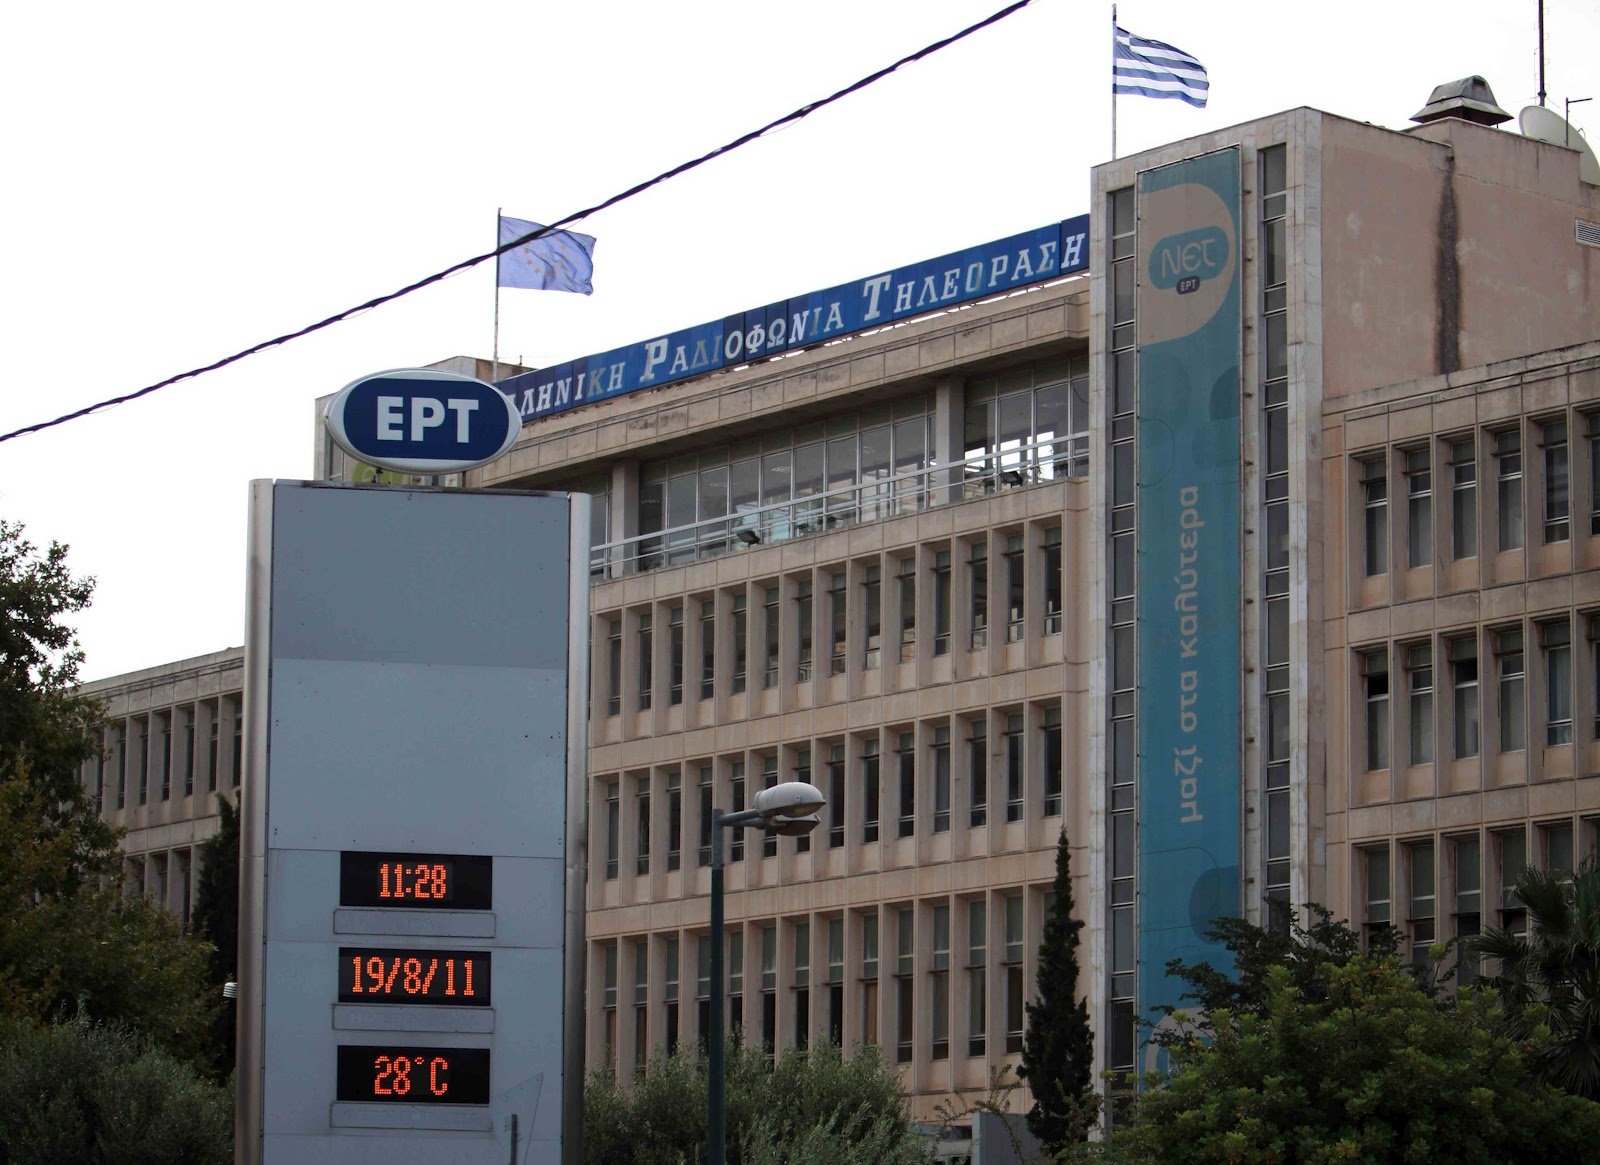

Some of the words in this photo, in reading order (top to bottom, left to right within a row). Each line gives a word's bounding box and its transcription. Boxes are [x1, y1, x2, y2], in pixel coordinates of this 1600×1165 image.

[639, 302, 844, 383] ΡΑΔΙΟΦΩΝΙΑ
[863, 233, 1086, 321] ΤΗΛΕΟΡΑΣΗ
[1180, 278, 1197, 292] ΕΡΤ
[376, 395, 479, 444] ΕΡΤ
[1174, 485, 1205, 659] καλύτερα
[1180, 670, 1198, 733] στα
[1174, 744, 1203, 824] μαζί
[379, 863, 447, 898] 11:28
[352, 956, 475, 996] 19/8/11
[374, 1055, 448, 1096] 28°C
